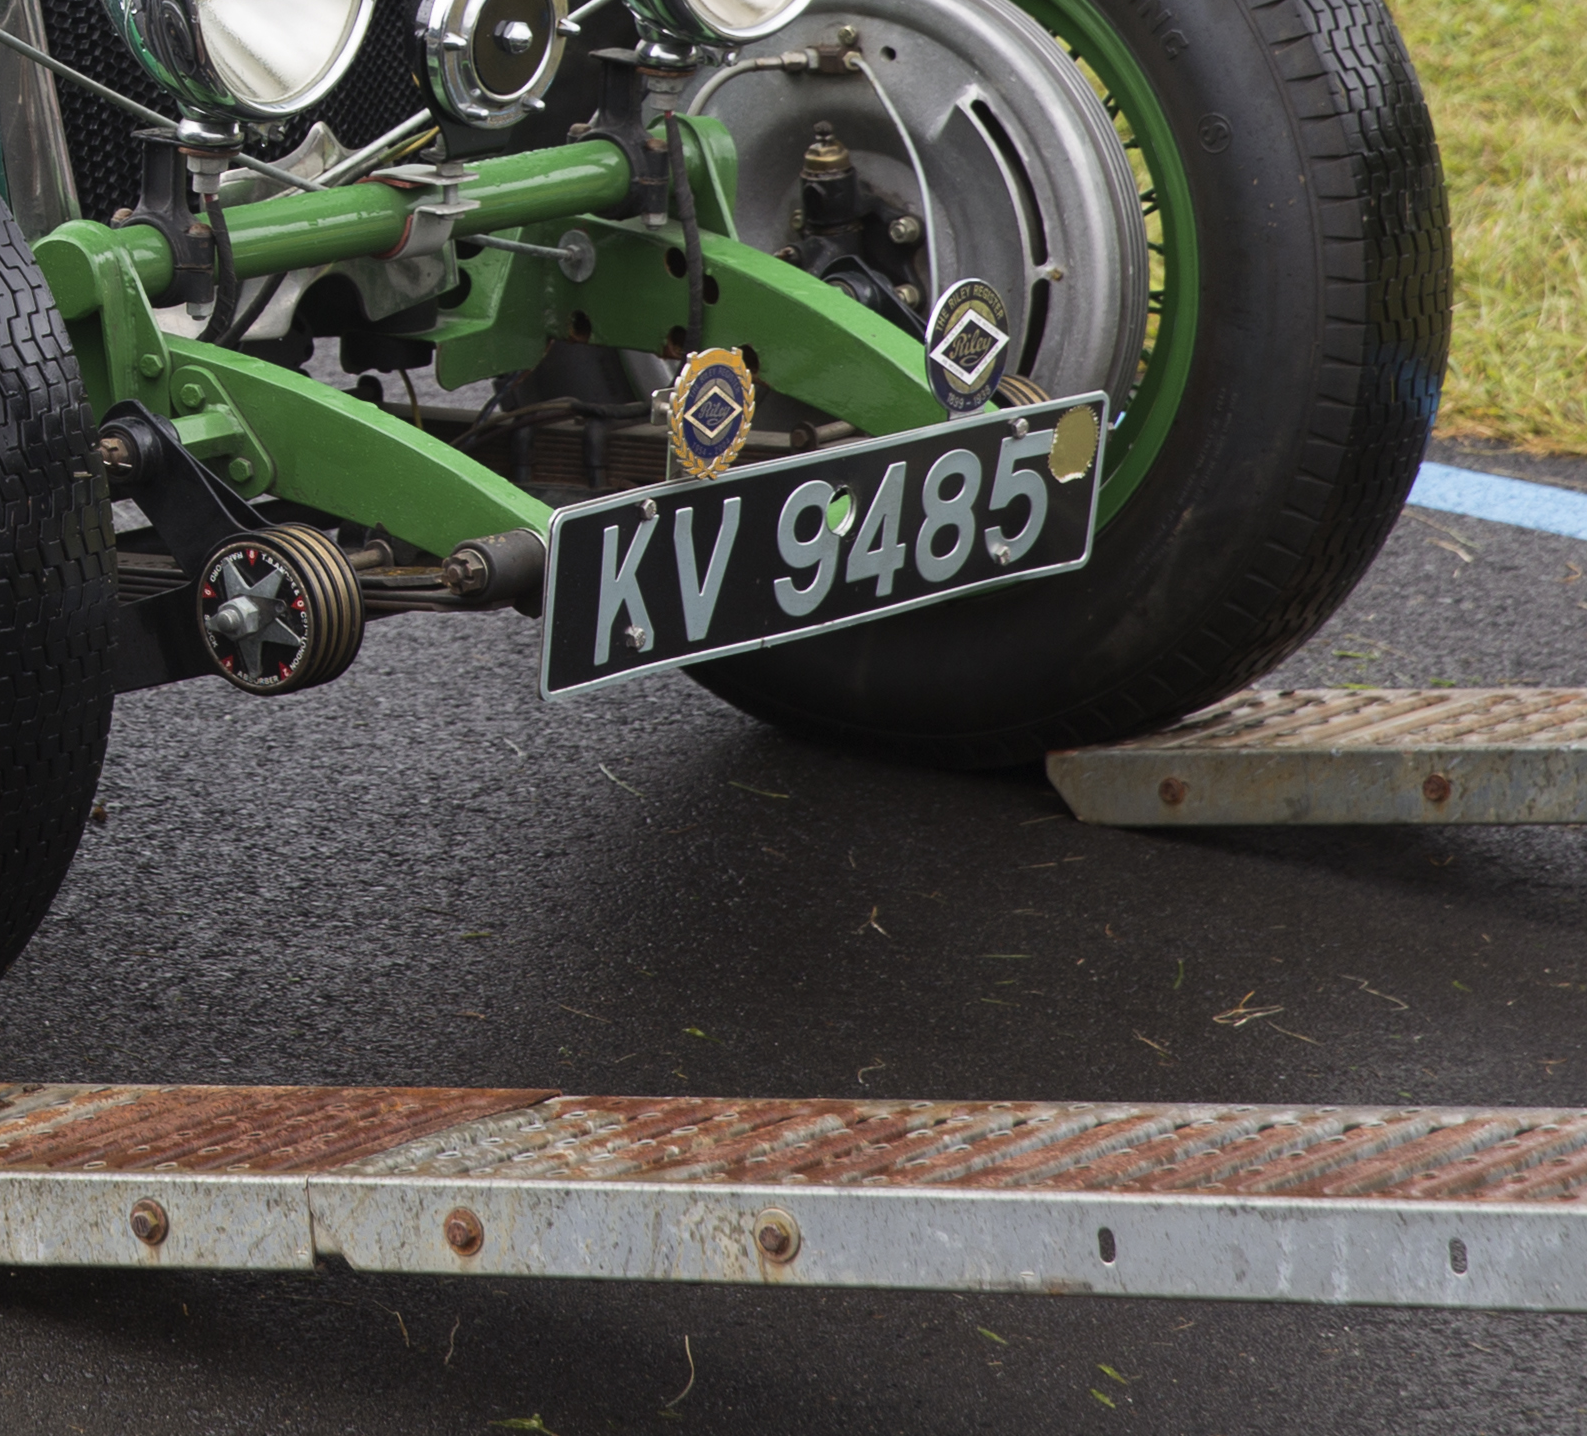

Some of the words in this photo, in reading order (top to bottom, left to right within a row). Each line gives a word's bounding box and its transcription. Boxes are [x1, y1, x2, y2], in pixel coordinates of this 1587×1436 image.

[935, 311, 950, 332] THE
[947, 285, 971, 310] RILEY
[972, 284, 1005, 320] REGISTER
[949, 329, 992, 367] Riley
[689, 382, 700, 399] THE
[699, 367, 717, 384] RILEY
[718, 366, 741, 395] REGISTER
[698, 400, 730, 426] Riley
[947, 393, 964, 409] 1899
[594, 497, 742, 666] KV
[773, 428, 1055, 616] 9485
